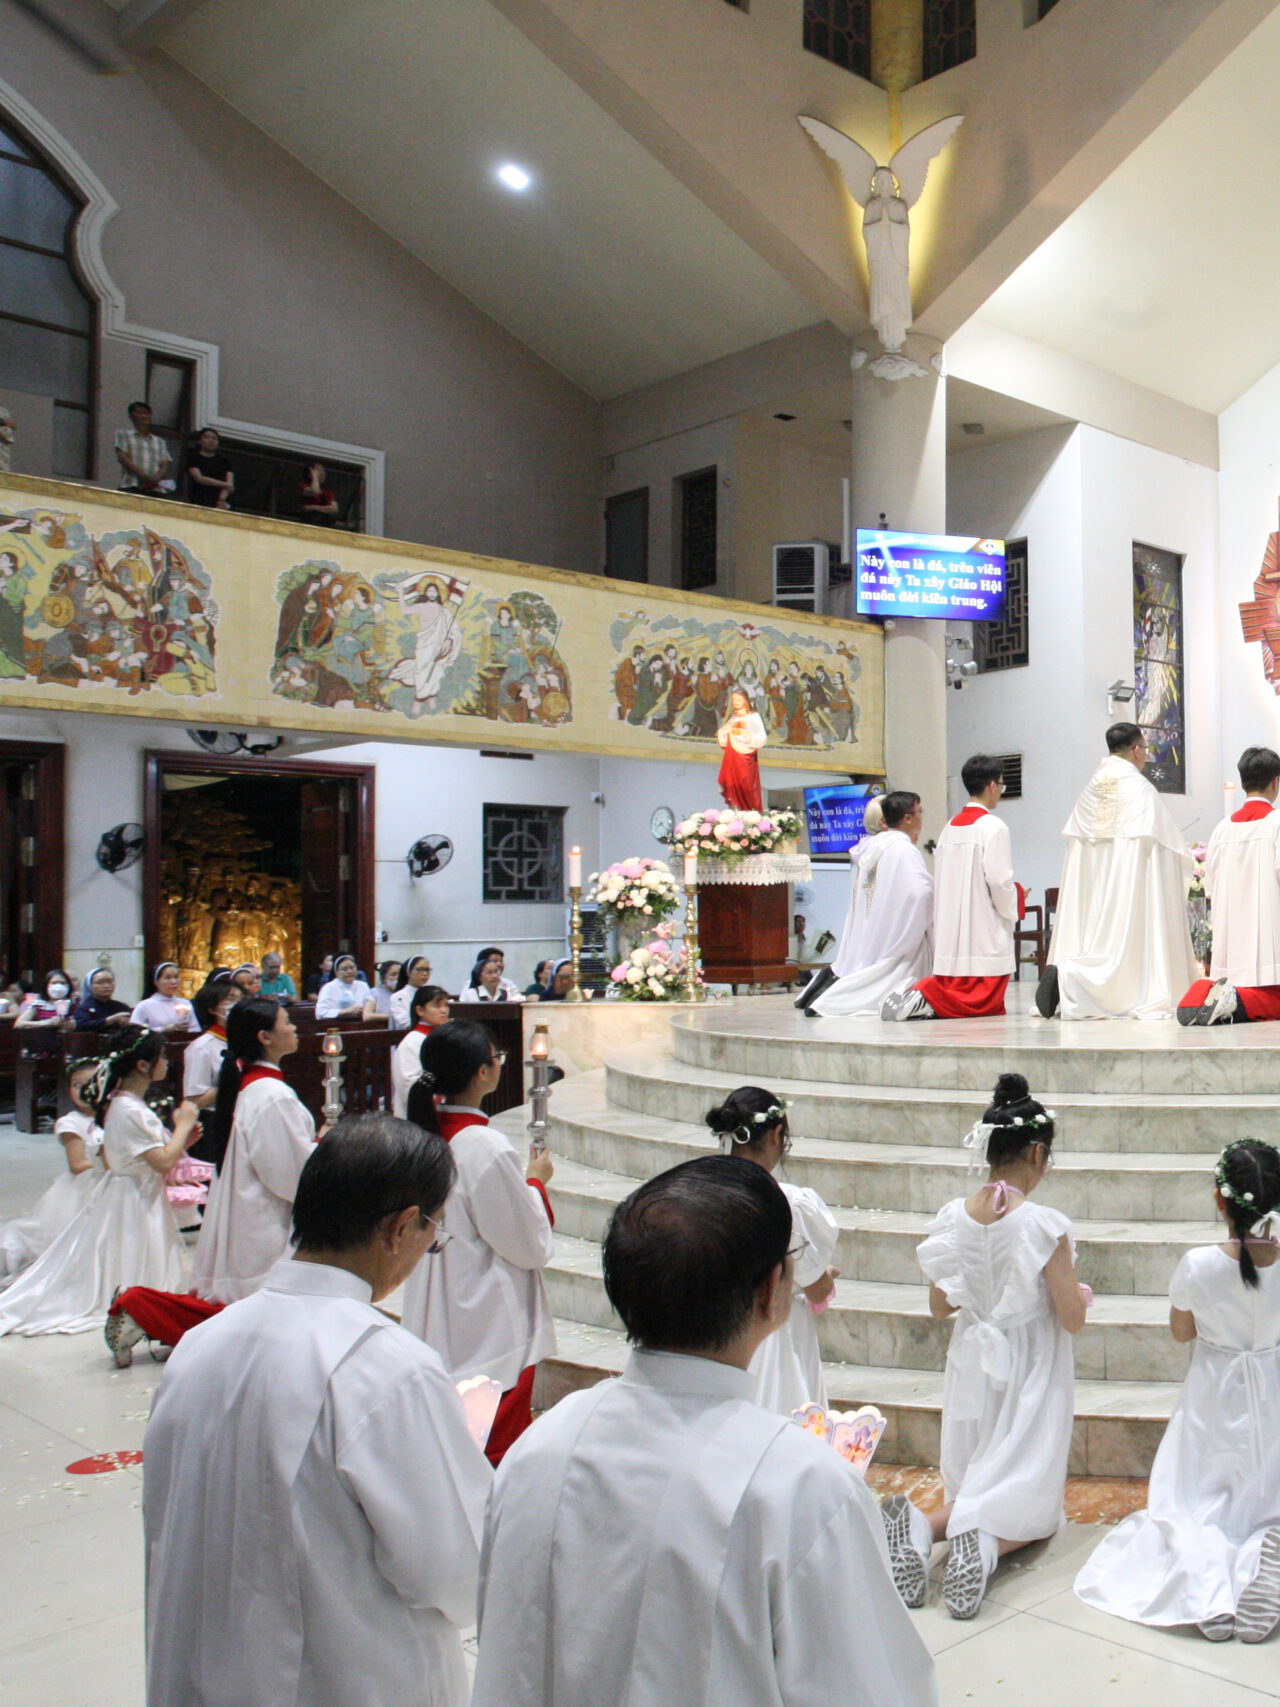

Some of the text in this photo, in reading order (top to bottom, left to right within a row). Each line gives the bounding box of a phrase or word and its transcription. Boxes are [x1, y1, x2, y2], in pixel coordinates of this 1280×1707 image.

[860, 555, 885, 570] Này
[889, 560, 910, 569] con
[913, 558, 925, 570] là
[949, 561, 974, 574] trên
[976, 563, 1002, 576] viên
[860, 571, 1002, 594] đá này Ta xây Giáo Hội
[860, 589, 896, 601] muôn
[950, 595, 988, 610] trung.
